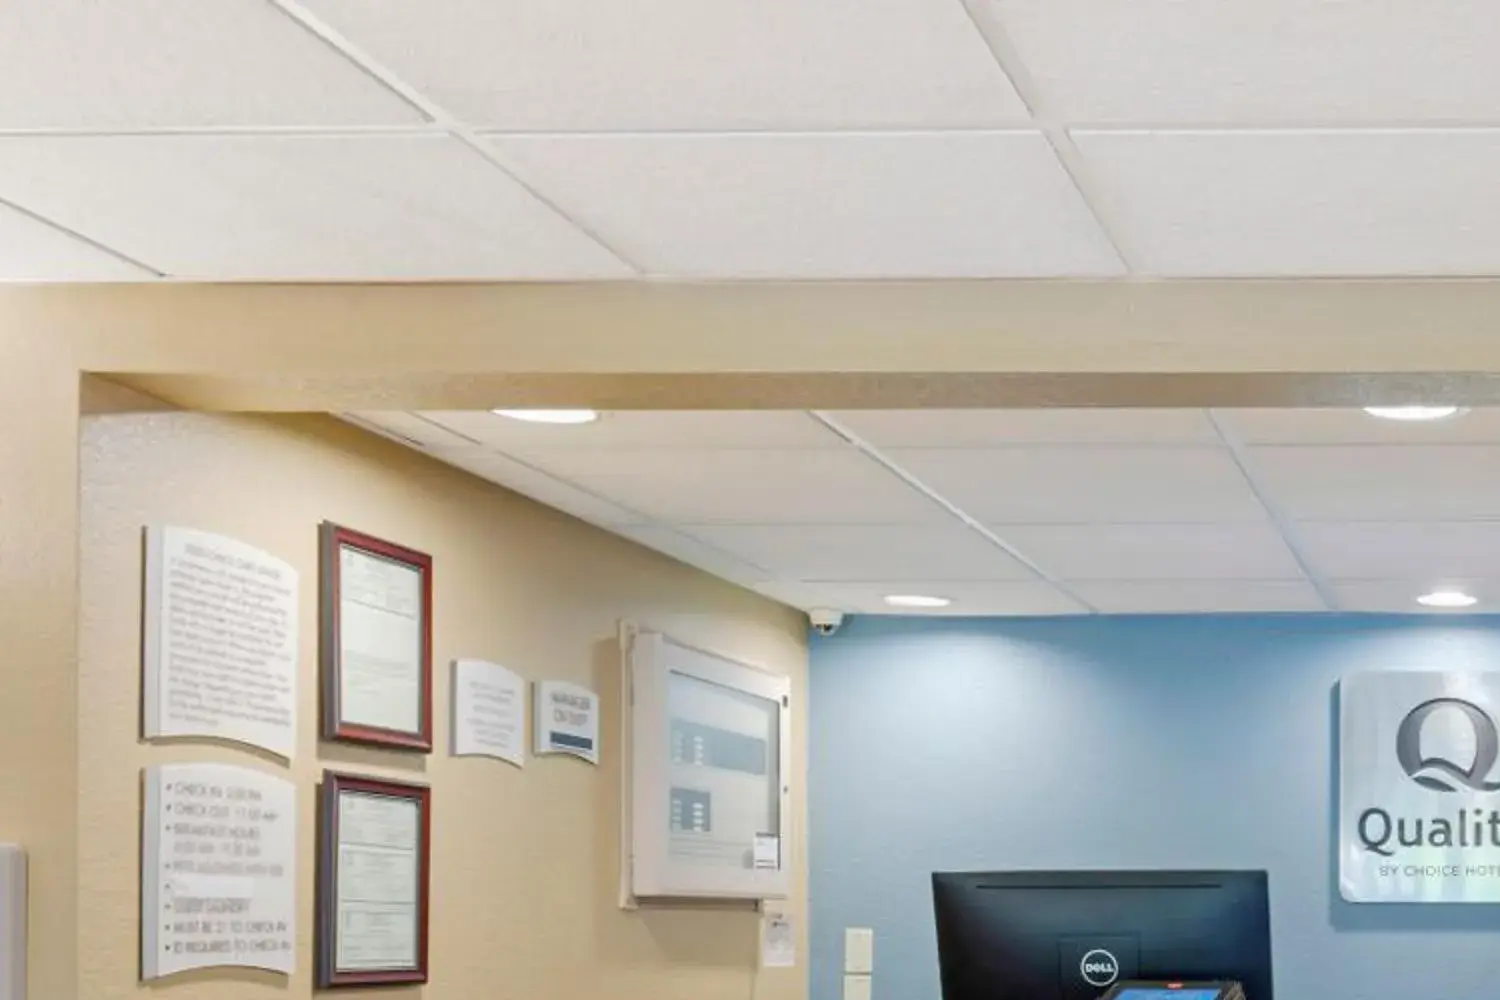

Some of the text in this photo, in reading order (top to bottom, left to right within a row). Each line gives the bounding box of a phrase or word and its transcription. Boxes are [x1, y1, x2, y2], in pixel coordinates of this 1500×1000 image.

[1379, 865, 1399, 877] BY
[1403, 865, 1460, 878] CHOICE
[1085, 962, 1114, 973] DELL
